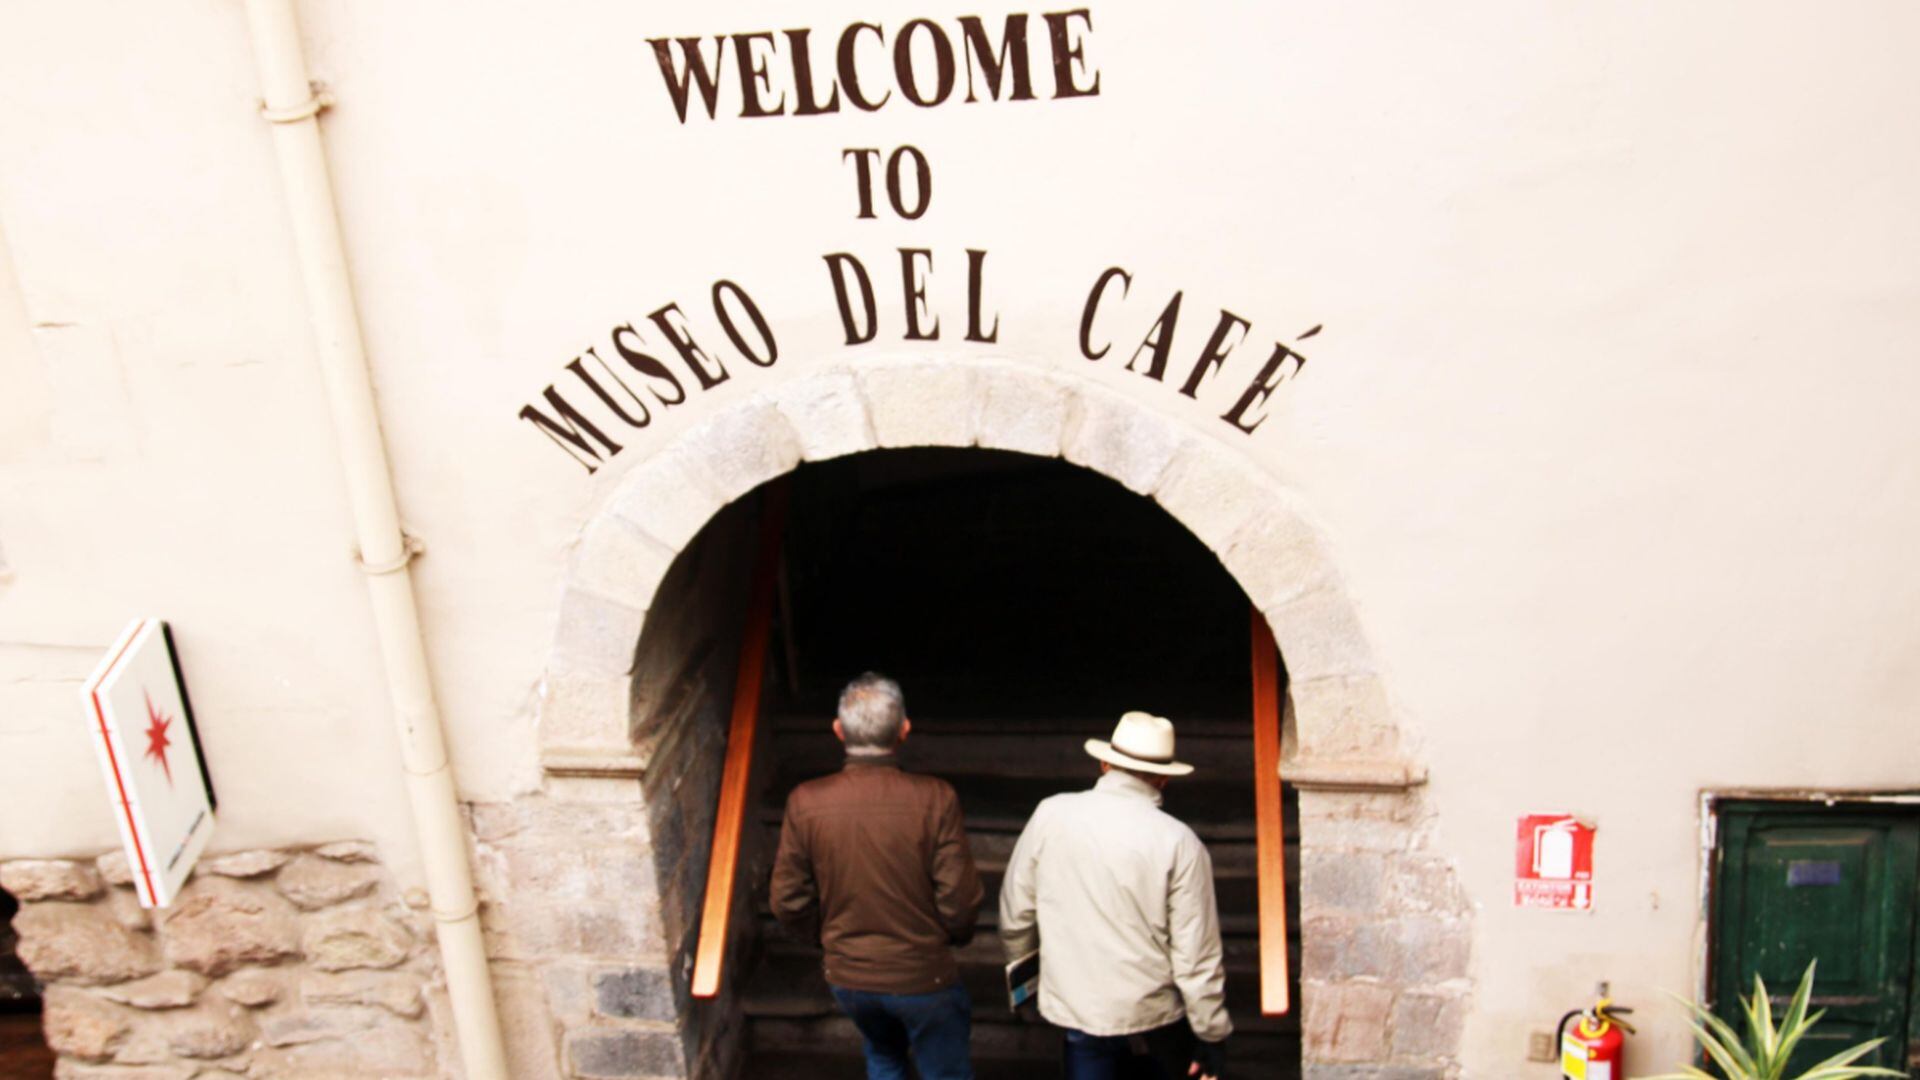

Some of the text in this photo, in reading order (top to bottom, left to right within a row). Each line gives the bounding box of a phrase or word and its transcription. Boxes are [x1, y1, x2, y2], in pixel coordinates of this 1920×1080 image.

[645, 8, 1100, 125] WELCOME
[842, 145, 932, 221] TO
[518, 248, 1323, 475] MUSEO DEL CAFÉ
